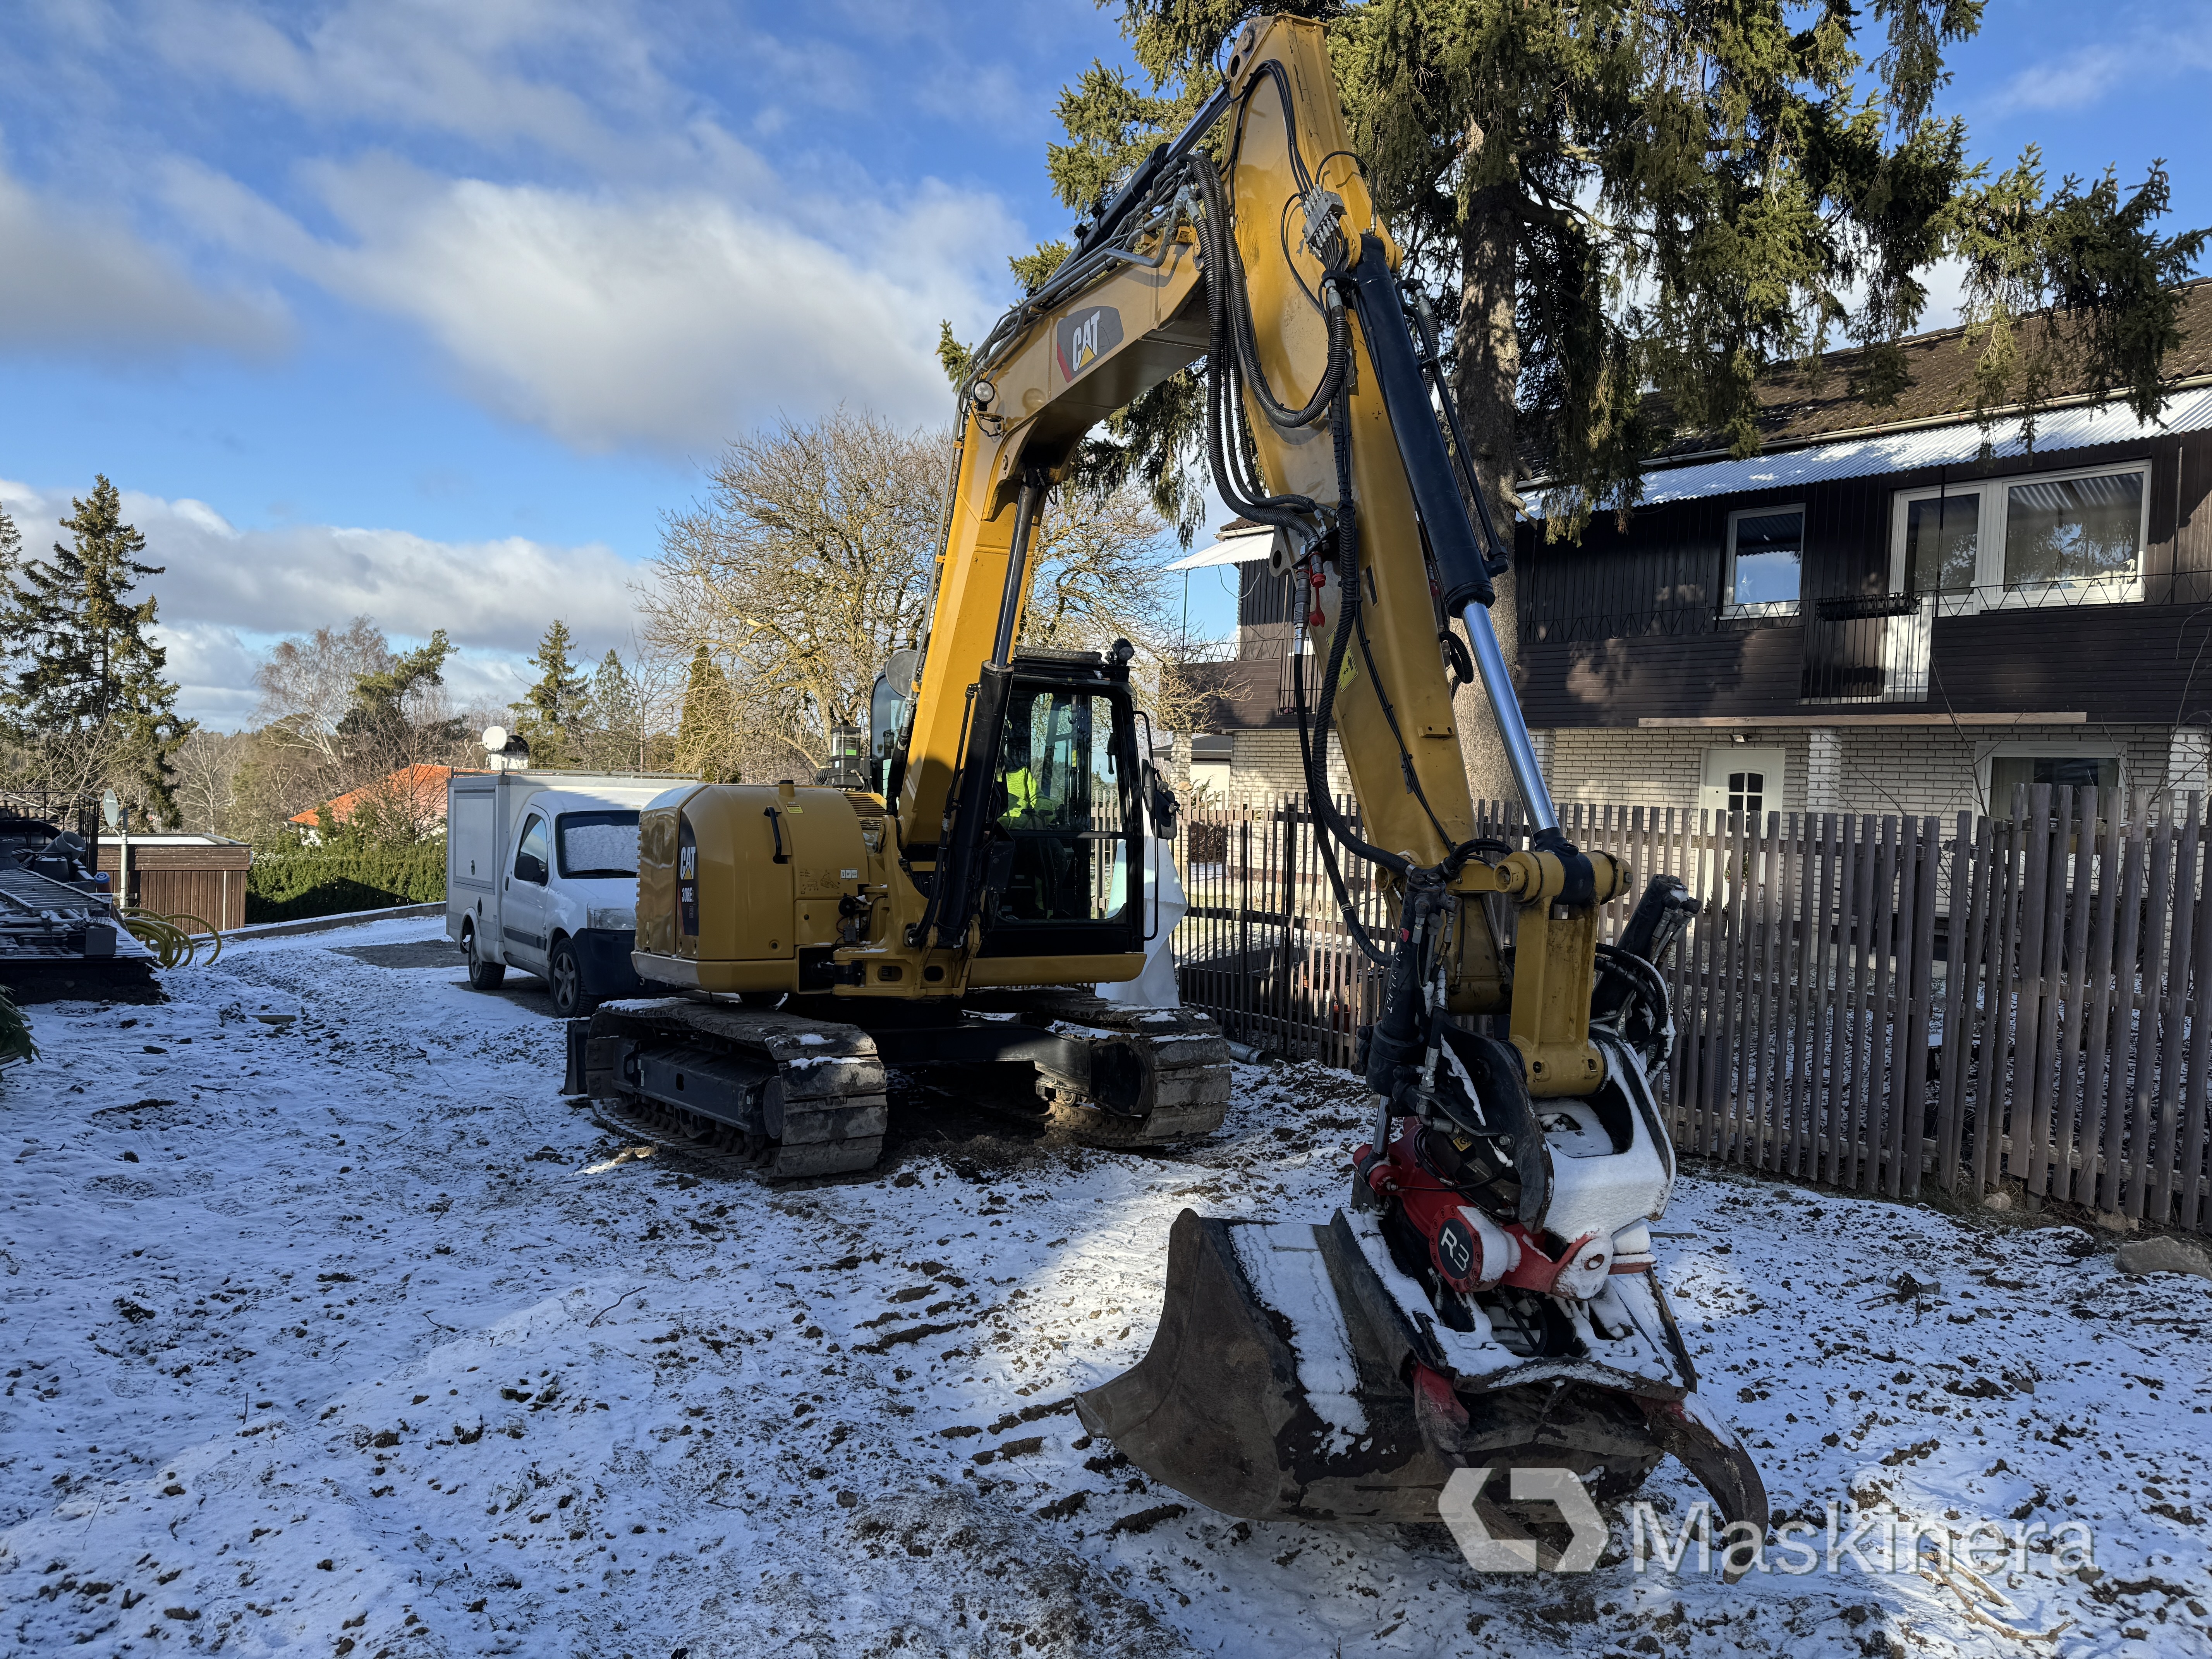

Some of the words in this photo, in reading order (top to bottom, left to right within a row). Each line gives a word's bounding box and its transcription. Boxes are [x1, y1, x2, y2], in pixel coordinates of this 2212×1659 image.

[1073, 310, 1100, 371] CAT
[680, 846, 696, 879] CAT
[1441, 1227, 1469, 1271] R3
